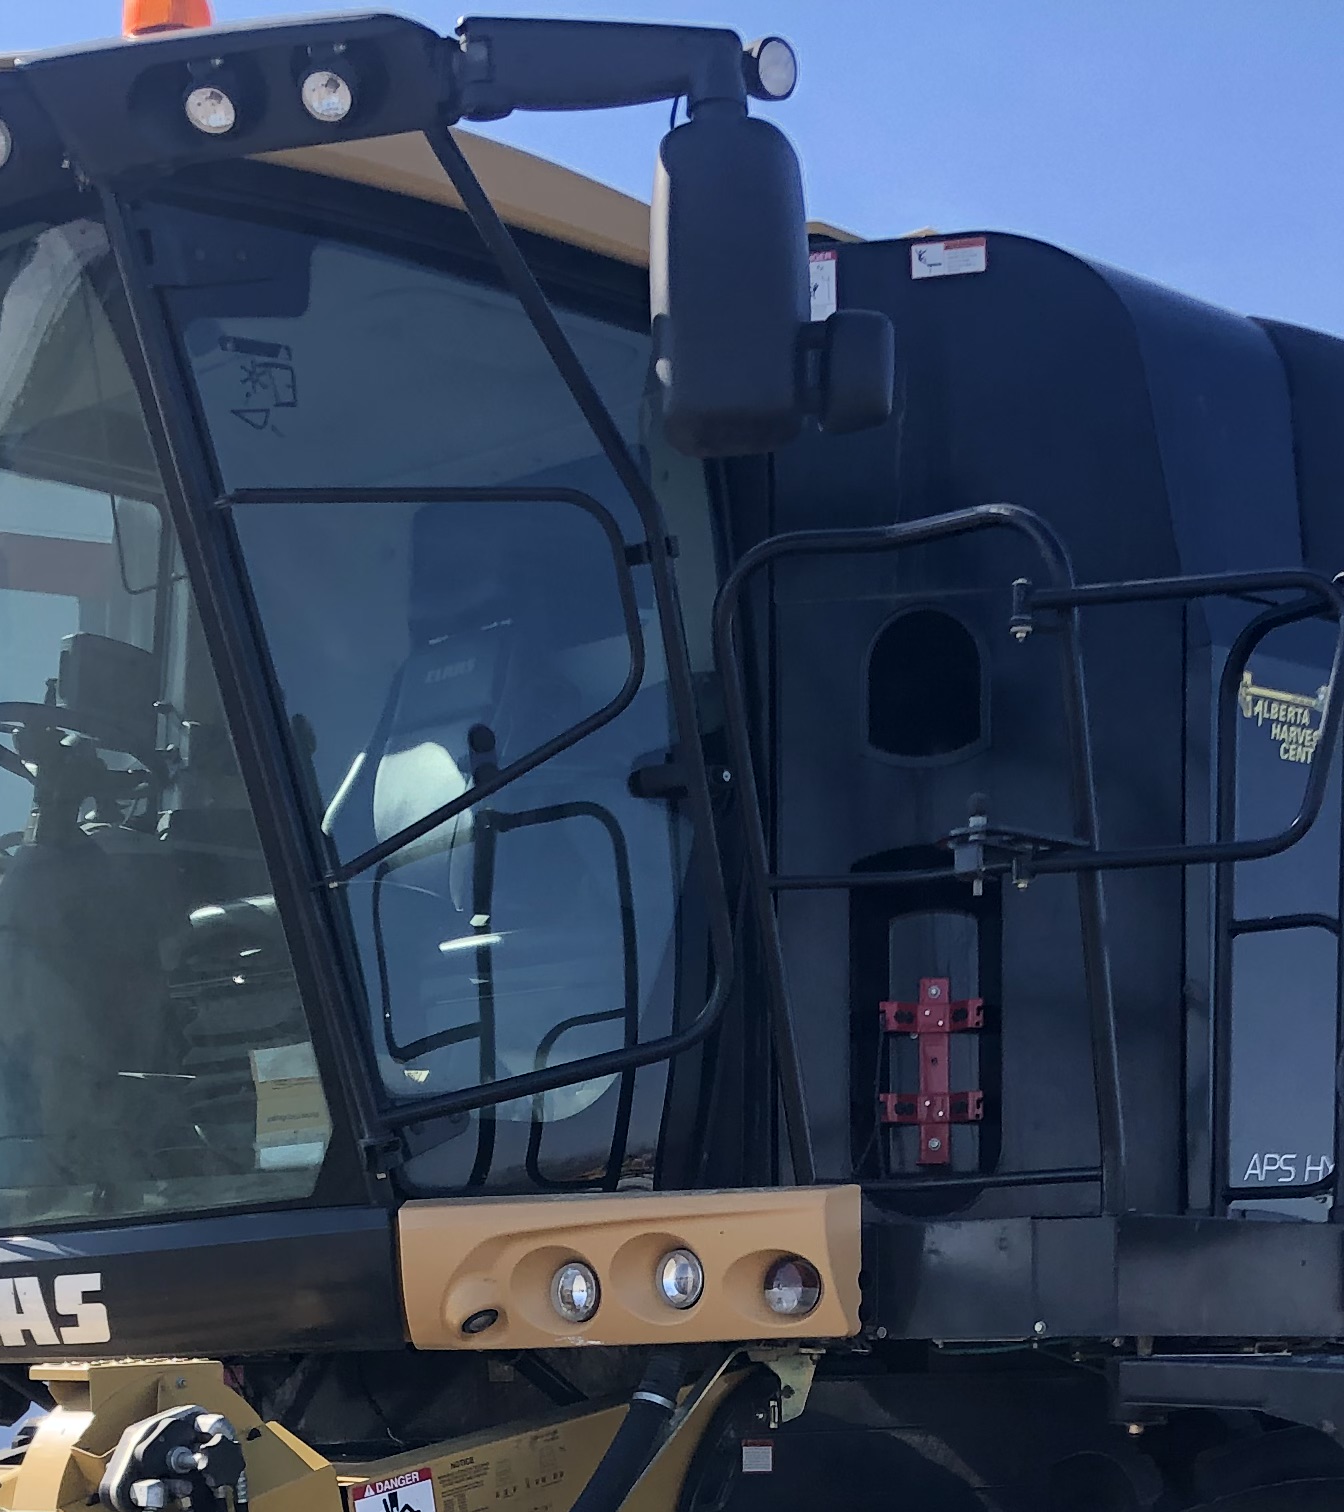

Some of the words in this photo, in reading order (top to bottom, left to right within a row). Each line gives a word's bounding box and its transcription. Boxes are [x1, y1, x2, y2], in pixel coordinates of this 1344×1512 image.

[1253, 698, 1311, 727] ALBERTA
[1270, 722, 1321, 748] HARVES
[1279, 743, 1315, 764] CENT
[1243, 1152, 1297, 1182] APS
[376, 1471, 419, 1493] DANGER
